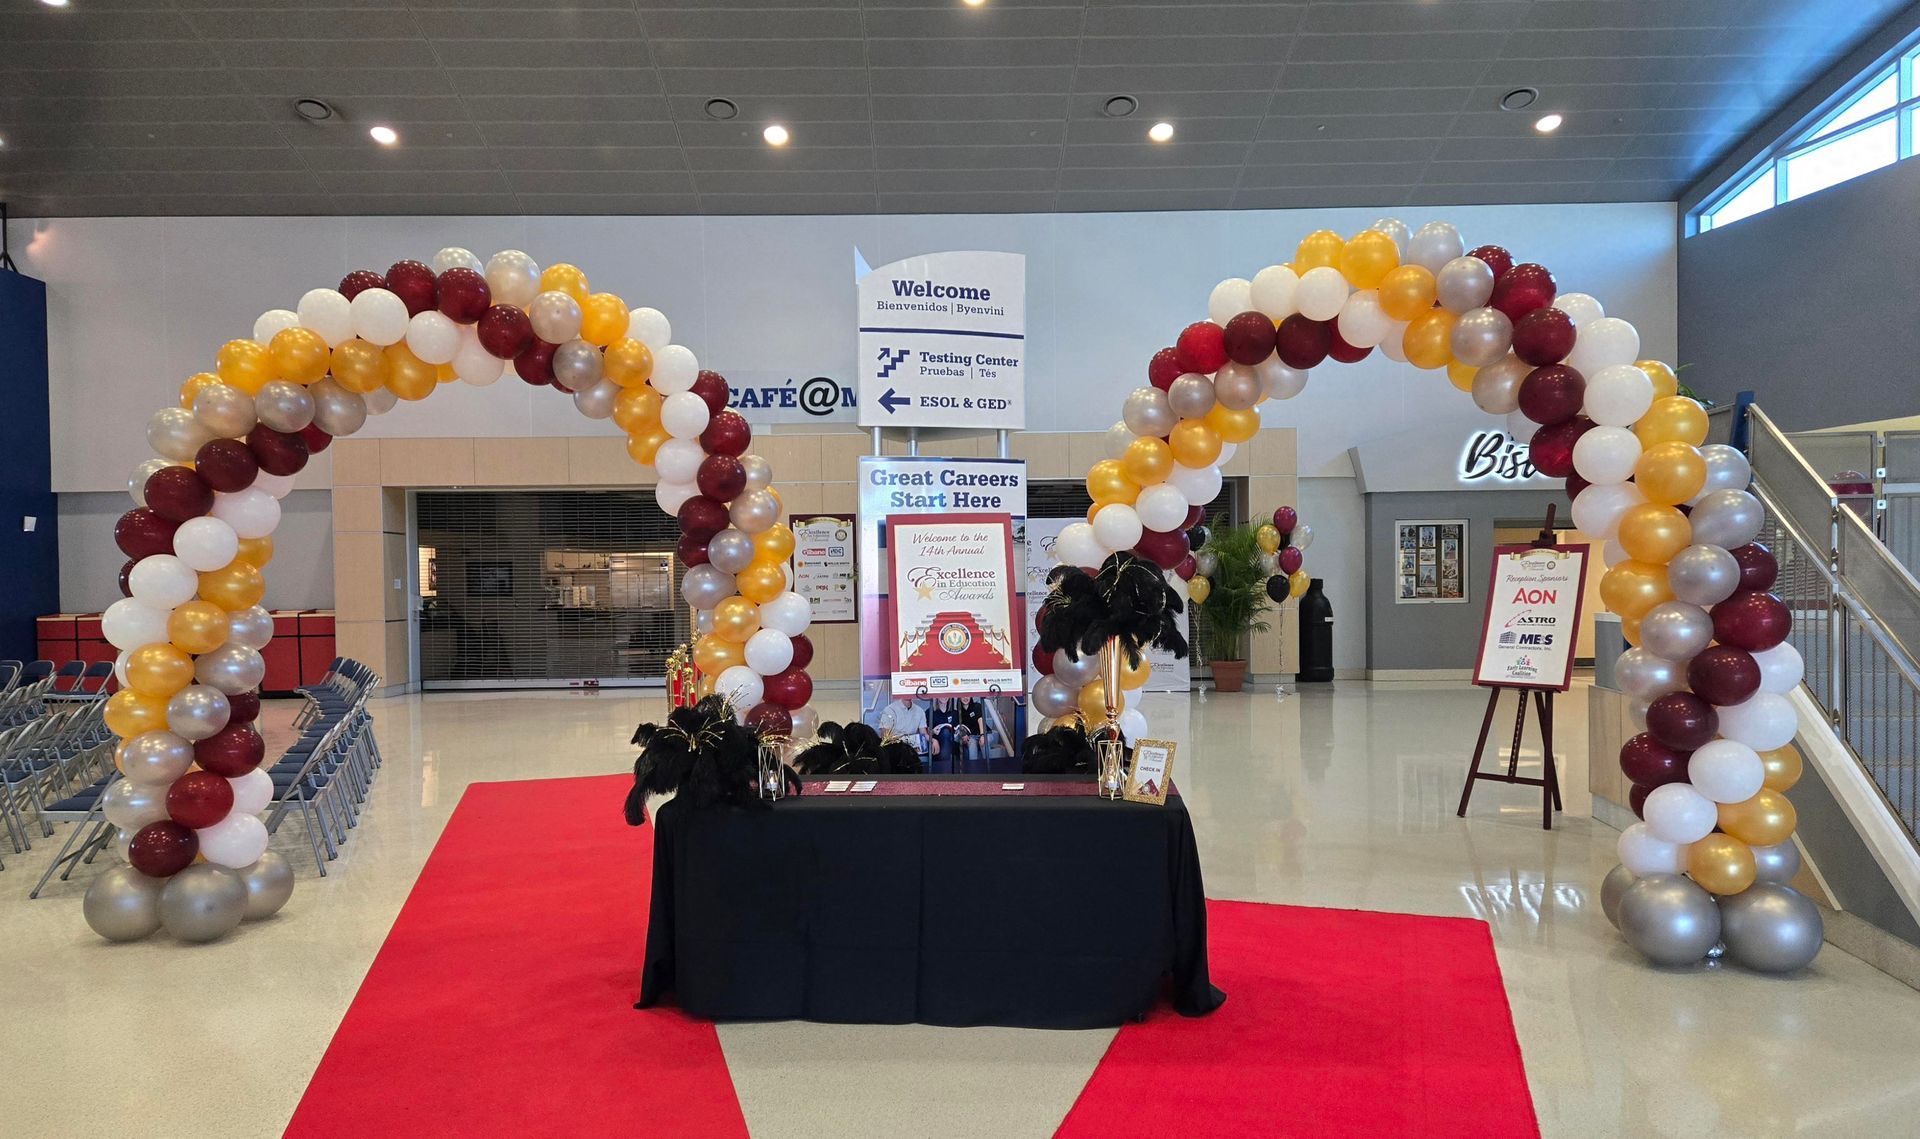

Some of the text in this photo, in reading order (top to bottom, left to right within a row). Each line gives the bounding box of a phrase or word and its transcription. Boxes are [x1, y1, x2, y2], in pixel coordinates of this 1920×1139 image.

[891, 280, 991, 301] Welcome
[876, 301, 1004, 316] Bienvenidos Byenvini
[919, 351, 1019, 367] Testing Center
[919, 366, 997, 378] Pruebas Tés
[919, 396, 959, 408] ESOL
[963, 397, 973, 408] &
[870, 469, 1019, 487] Great Careers
[890, 491, 1001, 508] Start Here
[912, 532, 988, 544] Welcome to the
[919, 545, 985, 556] 14th Annual
[907, 566, 995, 588] Excellence
[1506, 574, 1569, 585] Reception Sponsors
[949, 580, 996, 588] Education
[939, 588, 994, 601] Awards
[1512, 587, 1558, 605] AON
[1517, 616, 1556, 624] ASTRO
